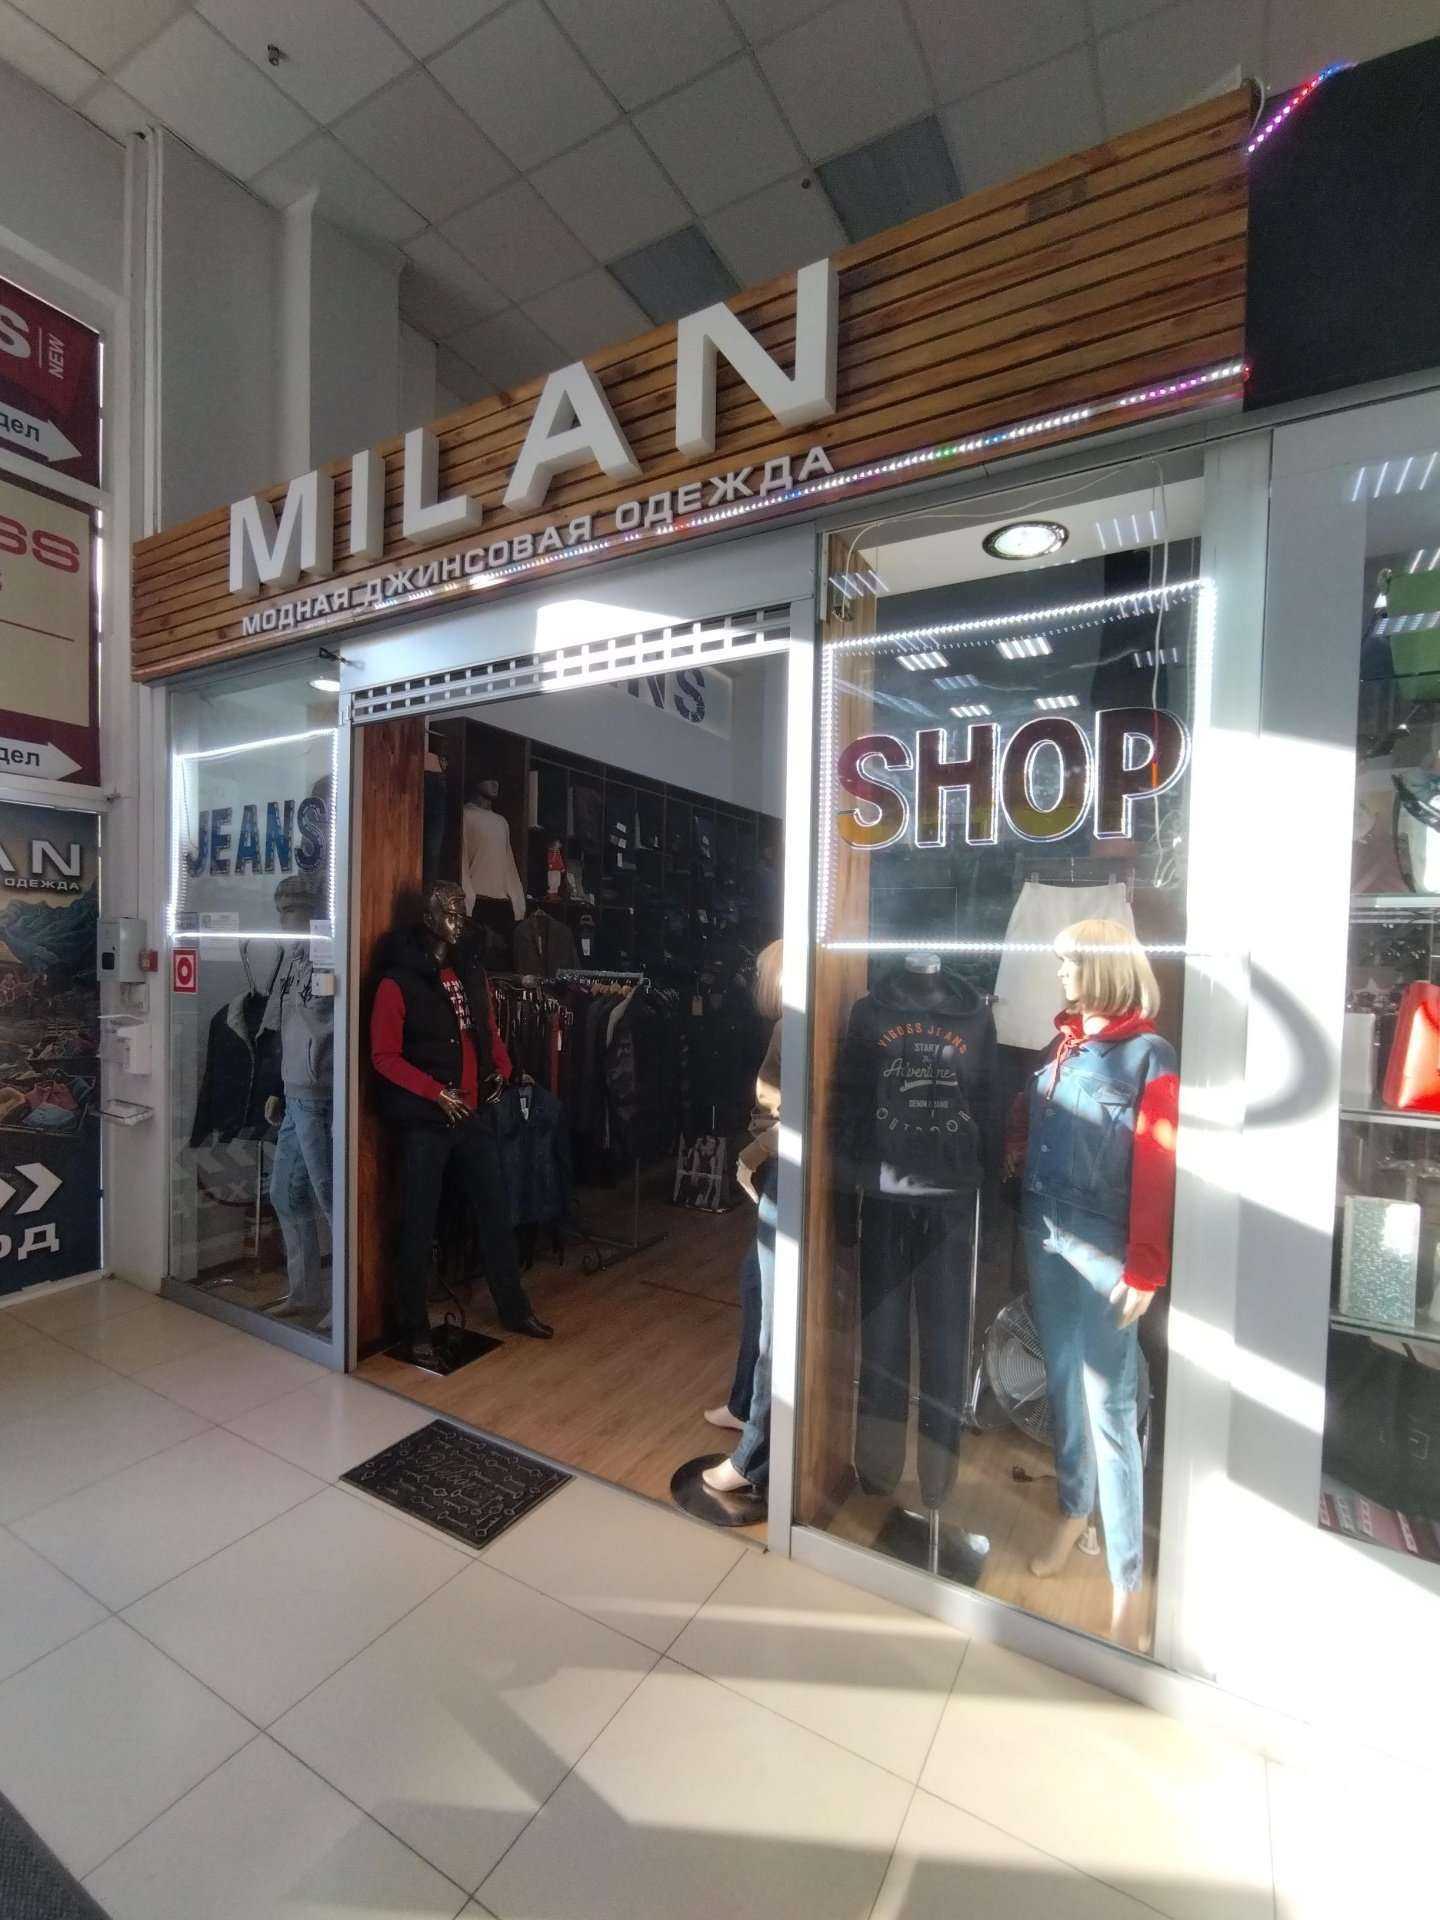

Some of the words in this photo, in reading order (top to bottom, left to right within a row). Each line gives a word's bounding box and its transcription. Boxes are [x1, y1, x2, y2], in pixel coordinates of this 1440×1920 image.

[48, 332, 65, 380] NEW
[230, 258, 838, 597] MILAN
[241, 587, 350, 636] МОДНАЯ
[364, 515, 593, 608] ДЖИНСОВАЯ
[615, 446, 835, 529] ОДЕЖДА
[837, 706, 1191, 851] SHOP
[4, 878, 80, 891] ОДЕЖДА
[187, 797, 329, 878] JEANS
